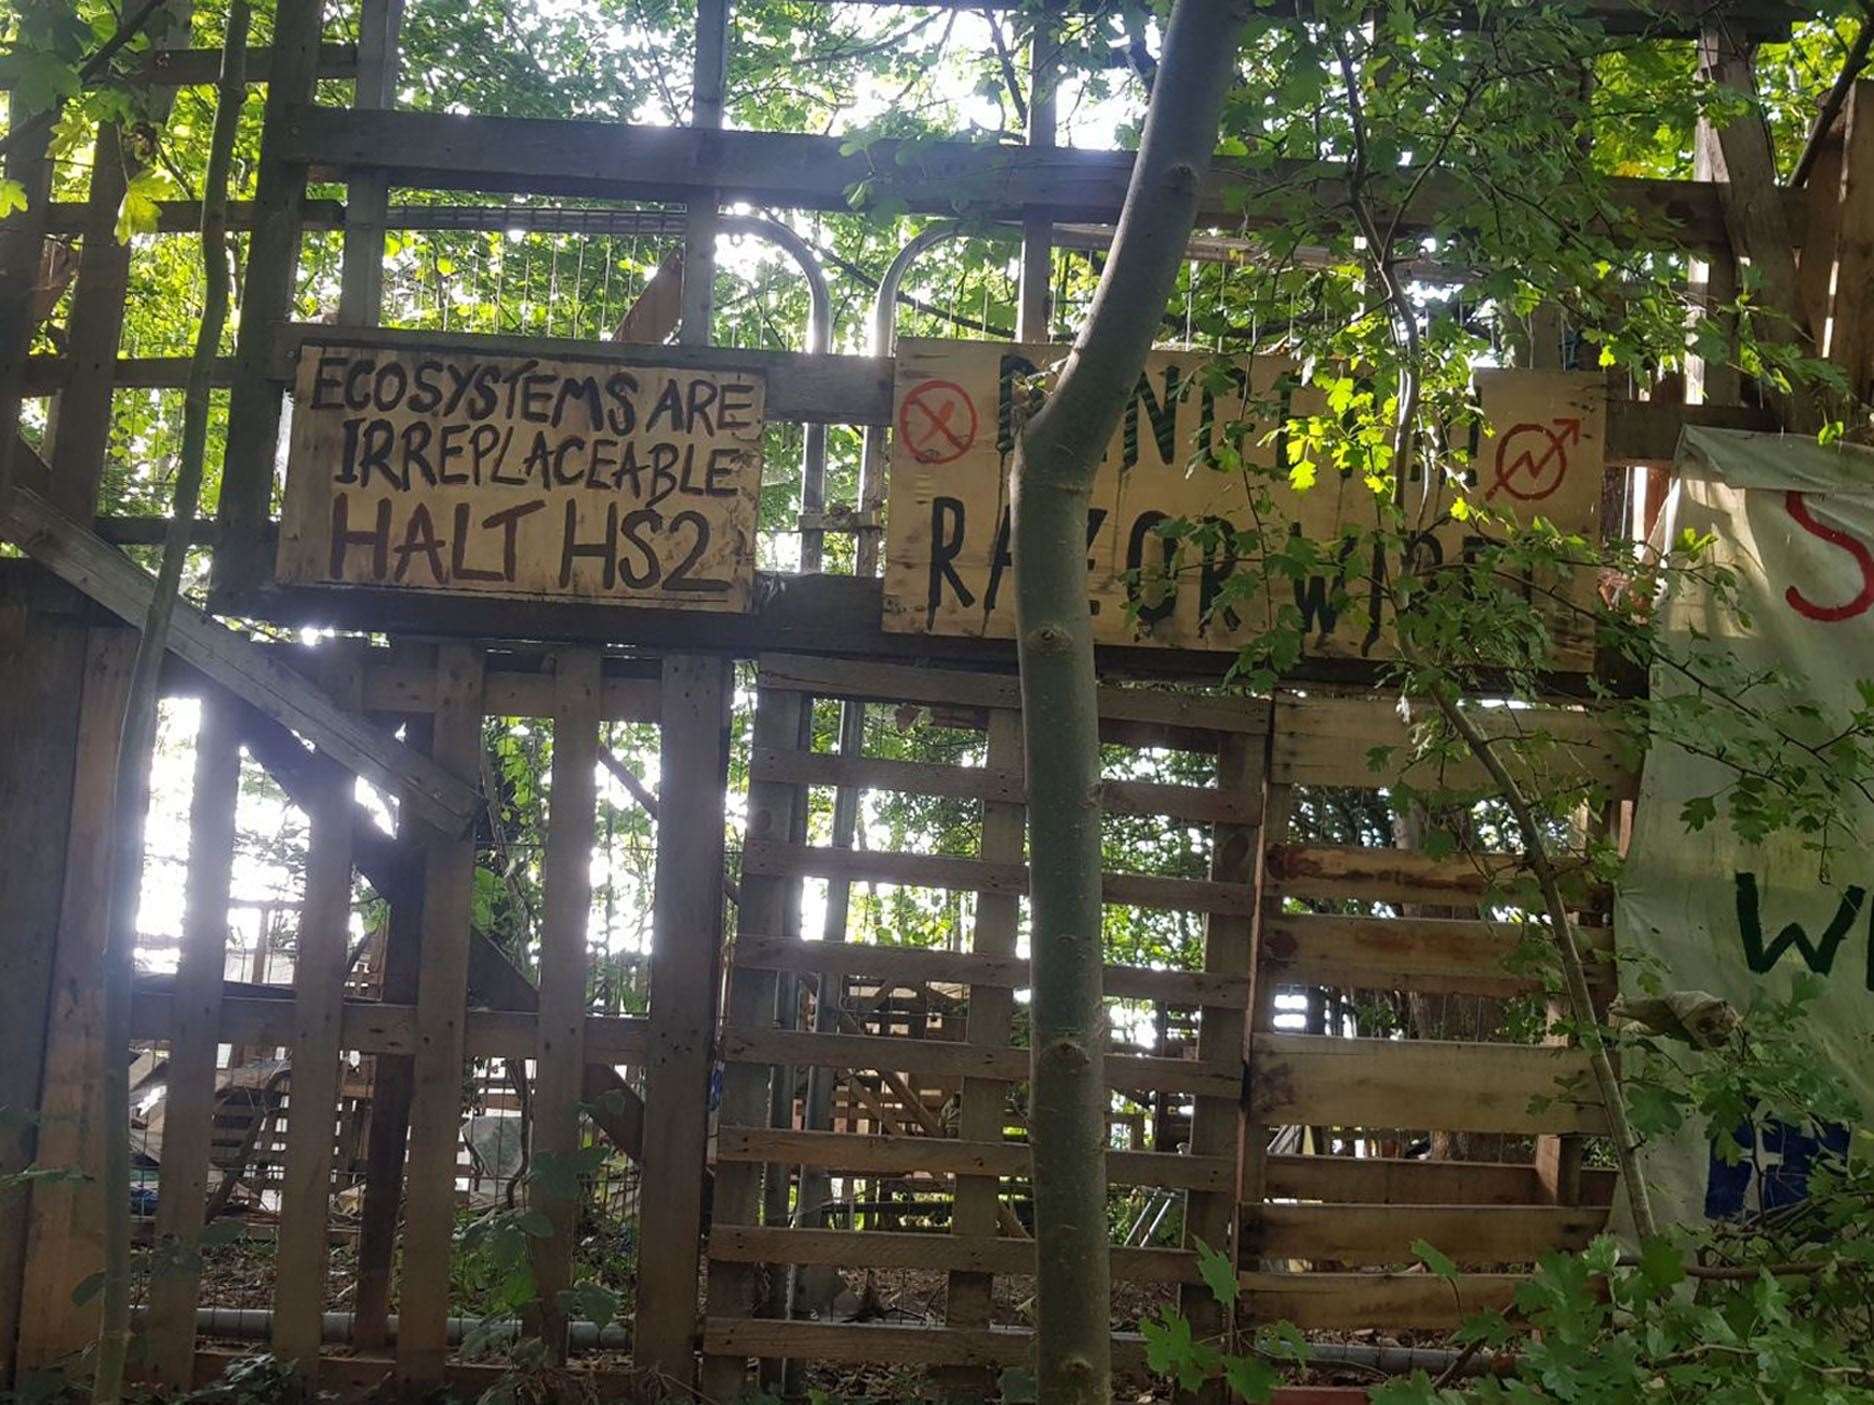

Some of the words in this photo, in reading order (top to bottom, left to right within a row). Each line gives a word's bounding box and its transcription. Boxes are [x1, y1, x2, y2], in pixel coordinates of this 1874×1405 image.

[311, 356, 639, 436] ECOSYSTEMS
[646, 377, 755, 436] ARE
[334, 417, 740, 508] IRREPLACEABLE
[329, 493, 546, 584] HALT
[558, 499, 734, 592] HS2
[927, 496, 1242, 633] ROR
